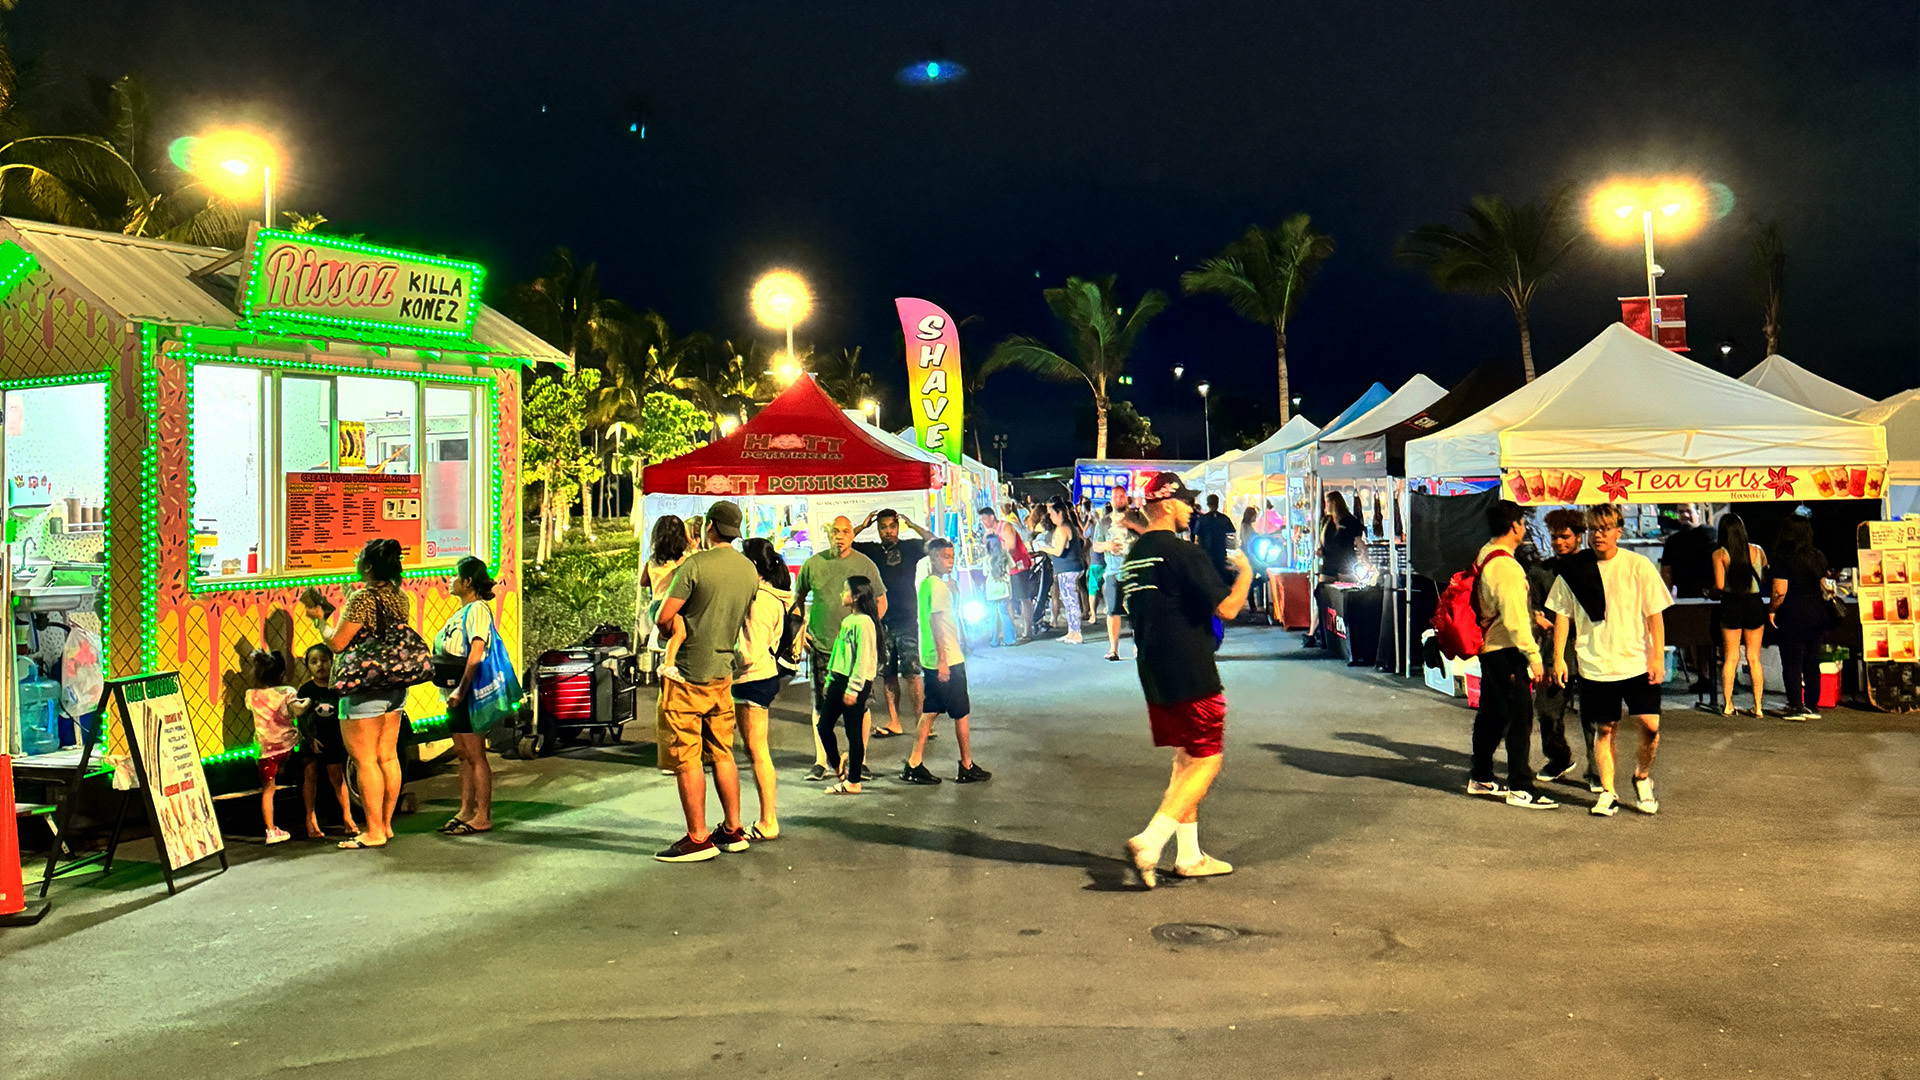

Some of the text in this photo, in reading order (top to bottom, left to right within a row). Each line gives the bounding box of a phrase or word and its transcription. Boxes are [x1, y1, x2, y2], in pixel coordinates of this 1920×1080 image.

[267, 244, 400, 307] Rissaz
[408, 271, 462, 297] KILLA
[400, 297, 459, 323] KONEZ
[916, 315, 949, 449] SHAVE
[741, 451, 843, 460] POTSTICKERS
[301, 473, 330, 482] CREATE
[331, 474, 352, 483] YOUR
[353, 474, 371, 483] OWN
[768, 474, 889, 493] POTSTICKERS
[1633, 467, 1765, 491] Tea Girls
[145, 676, 179, 699] CHURROS
